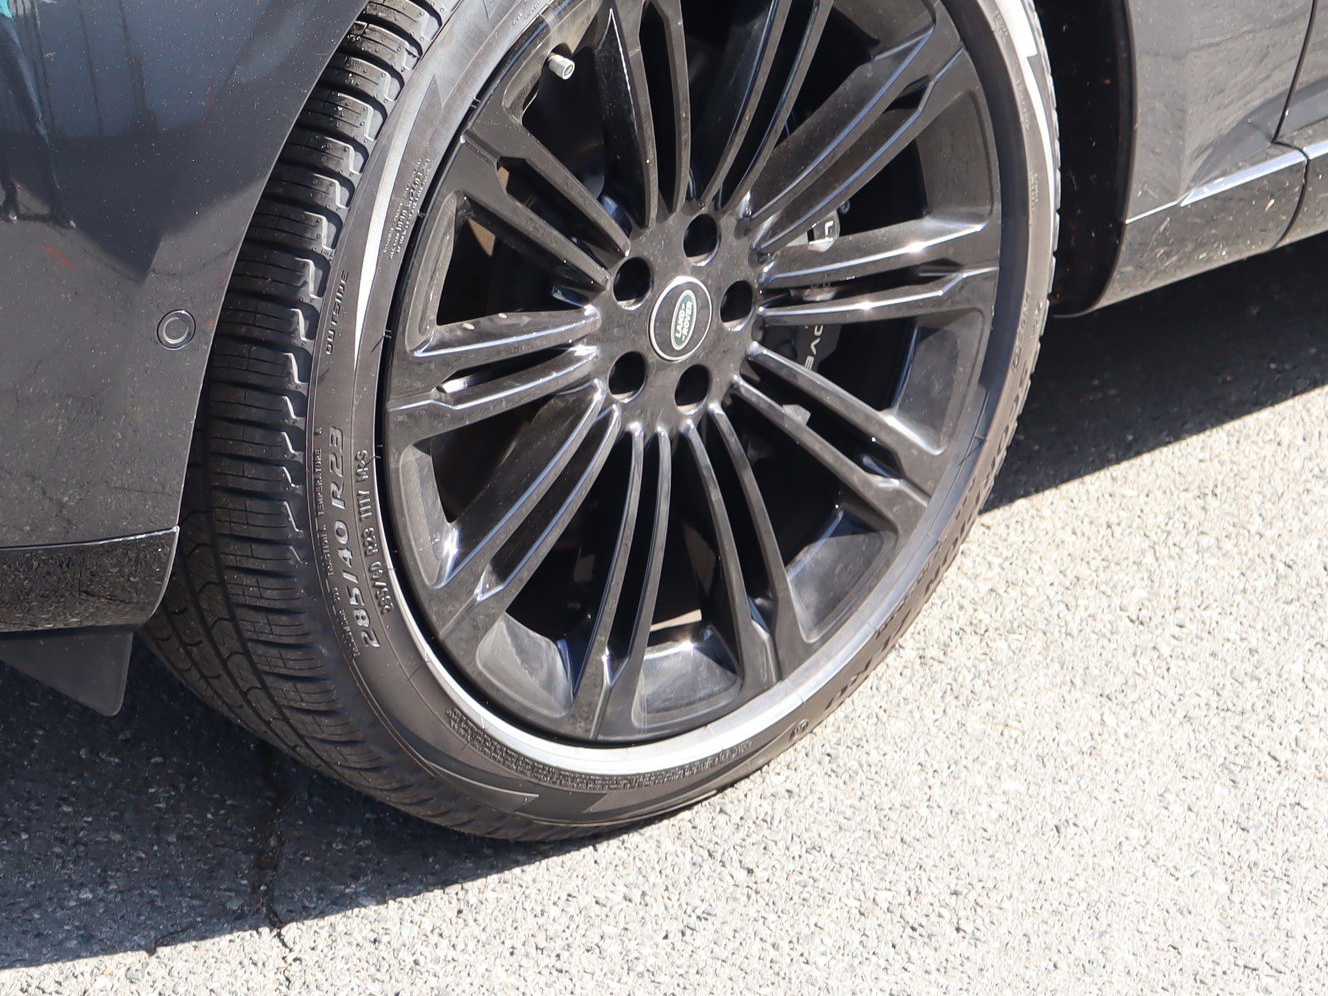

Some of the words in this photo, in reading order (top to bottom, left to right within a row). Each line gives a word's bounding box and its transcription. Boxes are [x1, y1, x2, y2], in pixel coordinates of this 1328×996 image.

[325, 270, 348, 355] OUTSIDE
[675, 309, 686, 338] LAND
[681, 301, 693, 337] ROVER
[314, 447, 325, 517] TEMPERATURE
[328, 425, 346, 511] R23
[360, 526, 379, 558] R23
[333, 518, 381, 648] 285/40
[368, 560, 394, 615] 285/40
